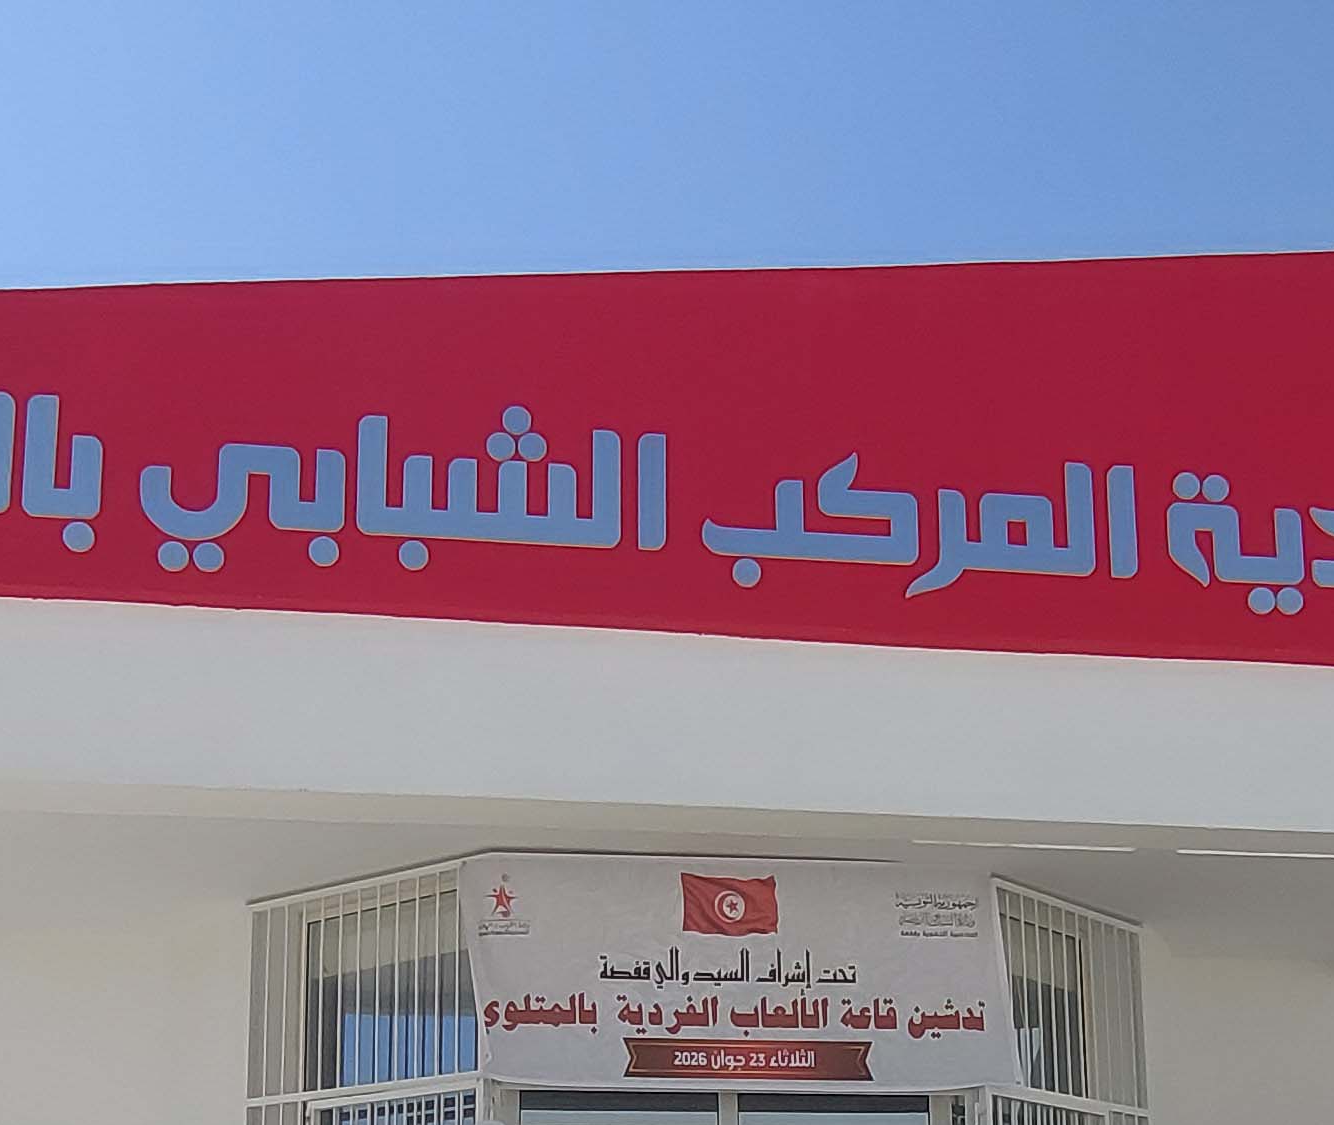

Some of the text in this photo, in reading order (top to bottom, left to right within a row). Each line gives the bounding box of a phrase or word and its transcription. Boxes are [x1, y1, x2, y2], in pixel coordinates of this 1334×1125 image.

[139, 405, 667, 573] الشبابي
[701, 452, 1138, 598] المركب
[599, 955, 651, 981] قفصة
[693, 946, 750, 987] السيد
[755, 947, 812, 989] إشراف
[816, 965, 857, 984] تحت
[616, 994, 719, 1035] الفردية
[730, 989, 829, 1038] الألعاب
[839, 998, 898, 1030] قاعة
[907, 998, 986, 1039] تدشين
[673, 1048, 816, 1071] الثلاثاء 23 جوان 2026
